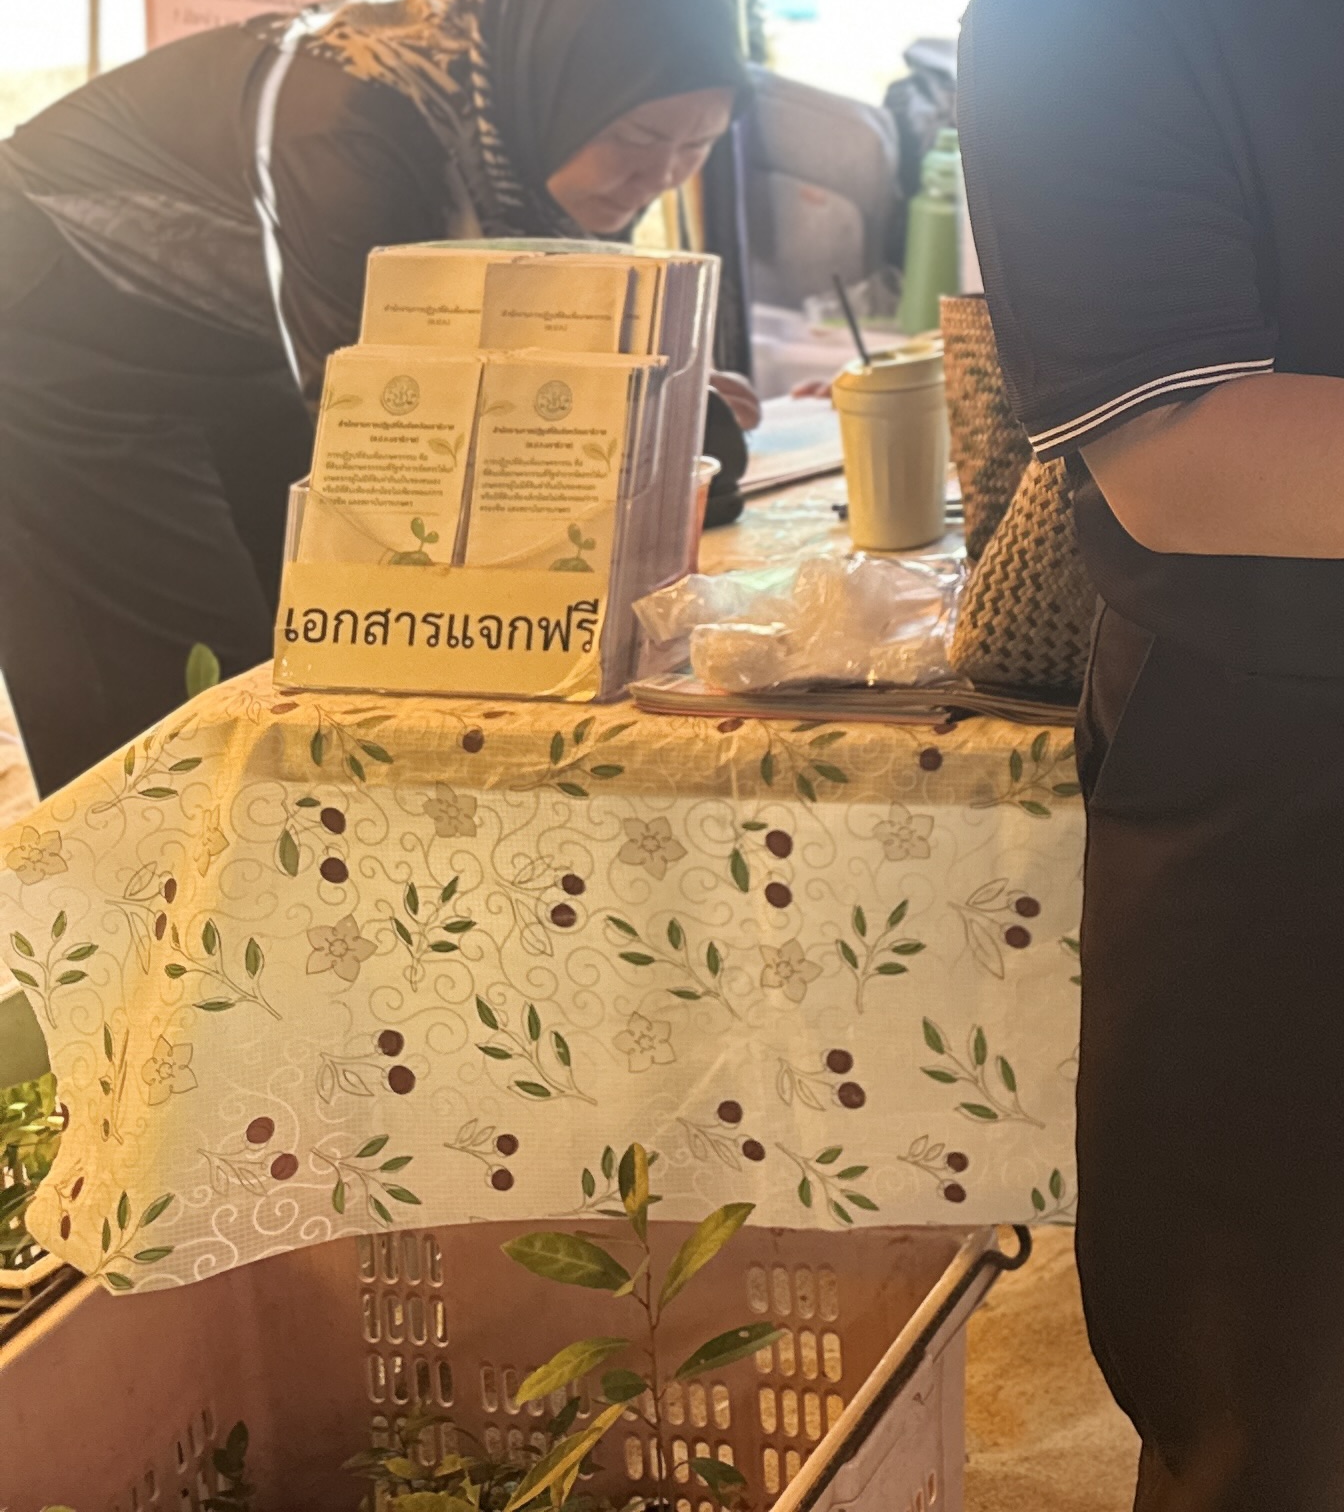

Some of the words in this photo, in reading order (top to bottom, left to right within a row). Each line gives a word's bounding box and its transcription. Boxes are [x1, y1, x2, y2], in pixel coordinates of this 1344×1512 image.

[284, 598, 601, 654] เอกสารแจกฟรี
